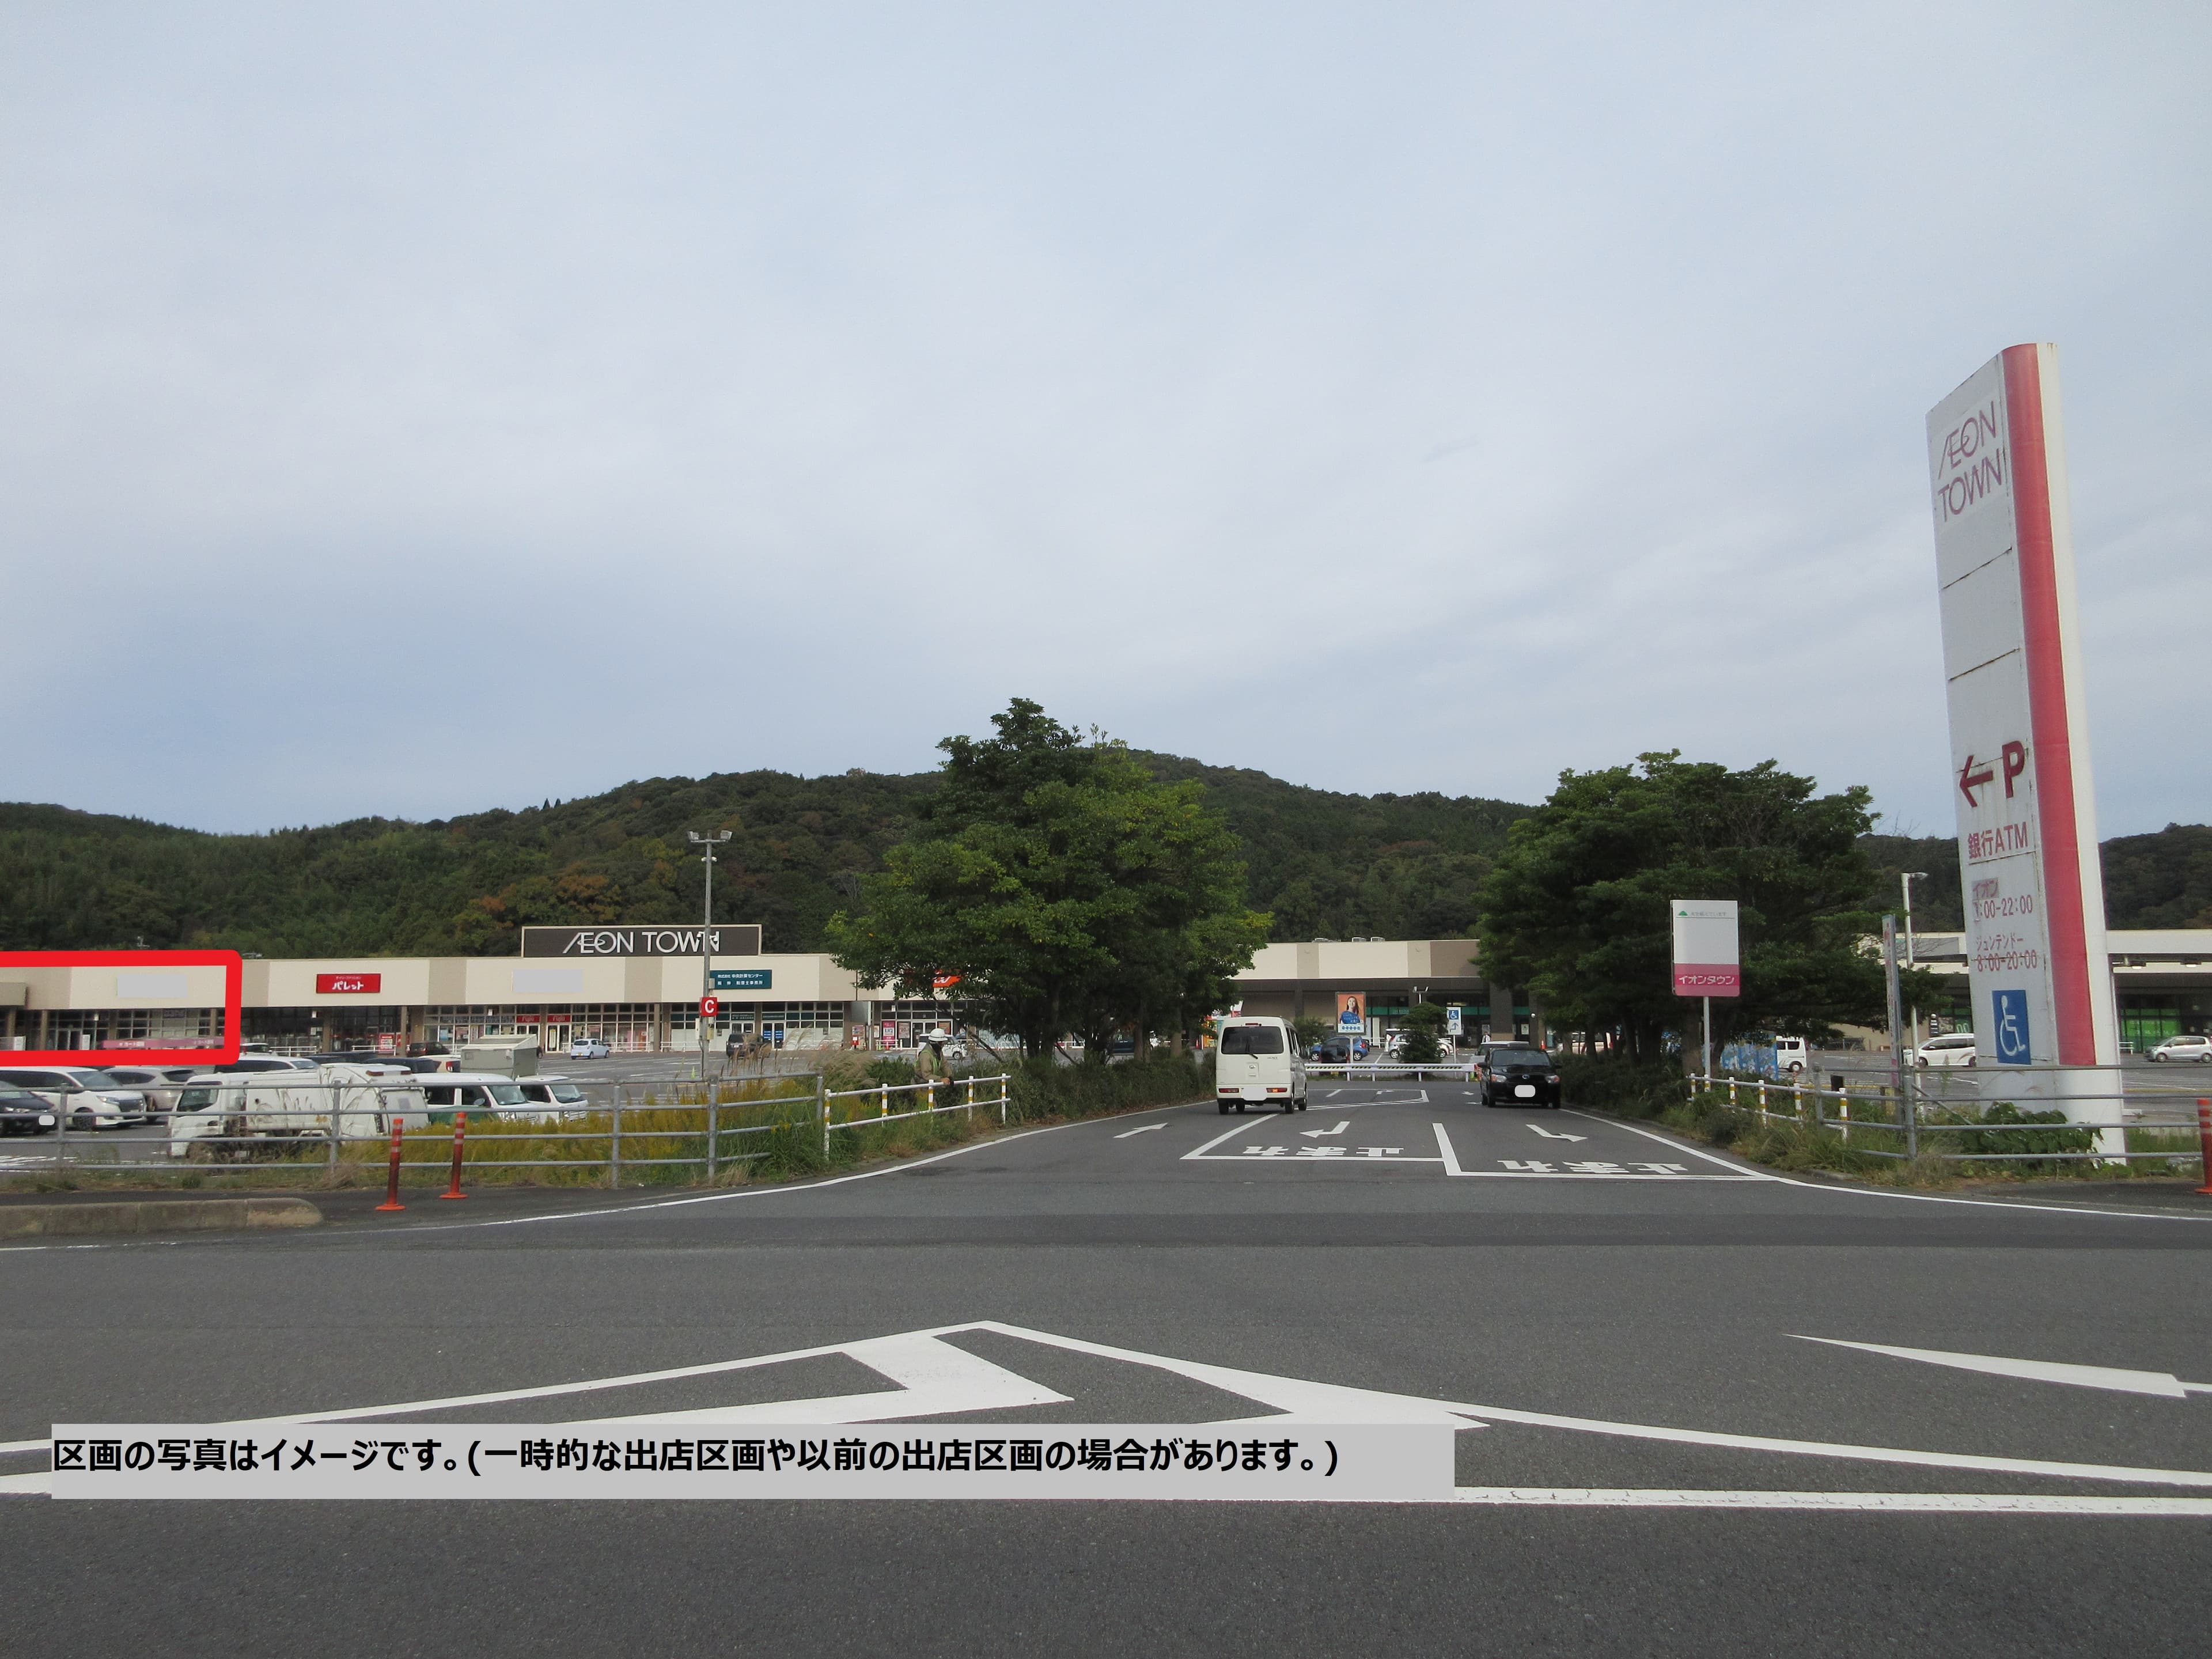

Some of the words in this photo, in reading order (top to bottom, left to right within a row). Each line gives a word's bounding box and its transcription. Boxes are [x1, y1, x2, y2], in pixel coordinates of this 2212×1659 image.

[1937, 448, 2002, 522] TOWN
[2002, 740, 2025, 798] P
[1968, 821, 2028, 859] 銀行ATM
[641, 931, 719, 953] TOWN
[1976, 932, 2024, 951] ジュンテンドー
[1976, 949, 2037, 972] 8:00-20:00
[332, 980, 364, 990] パレット
[1679, 975, 1734, 984] イオンタウン
[704, 999, 715, 1013] C
